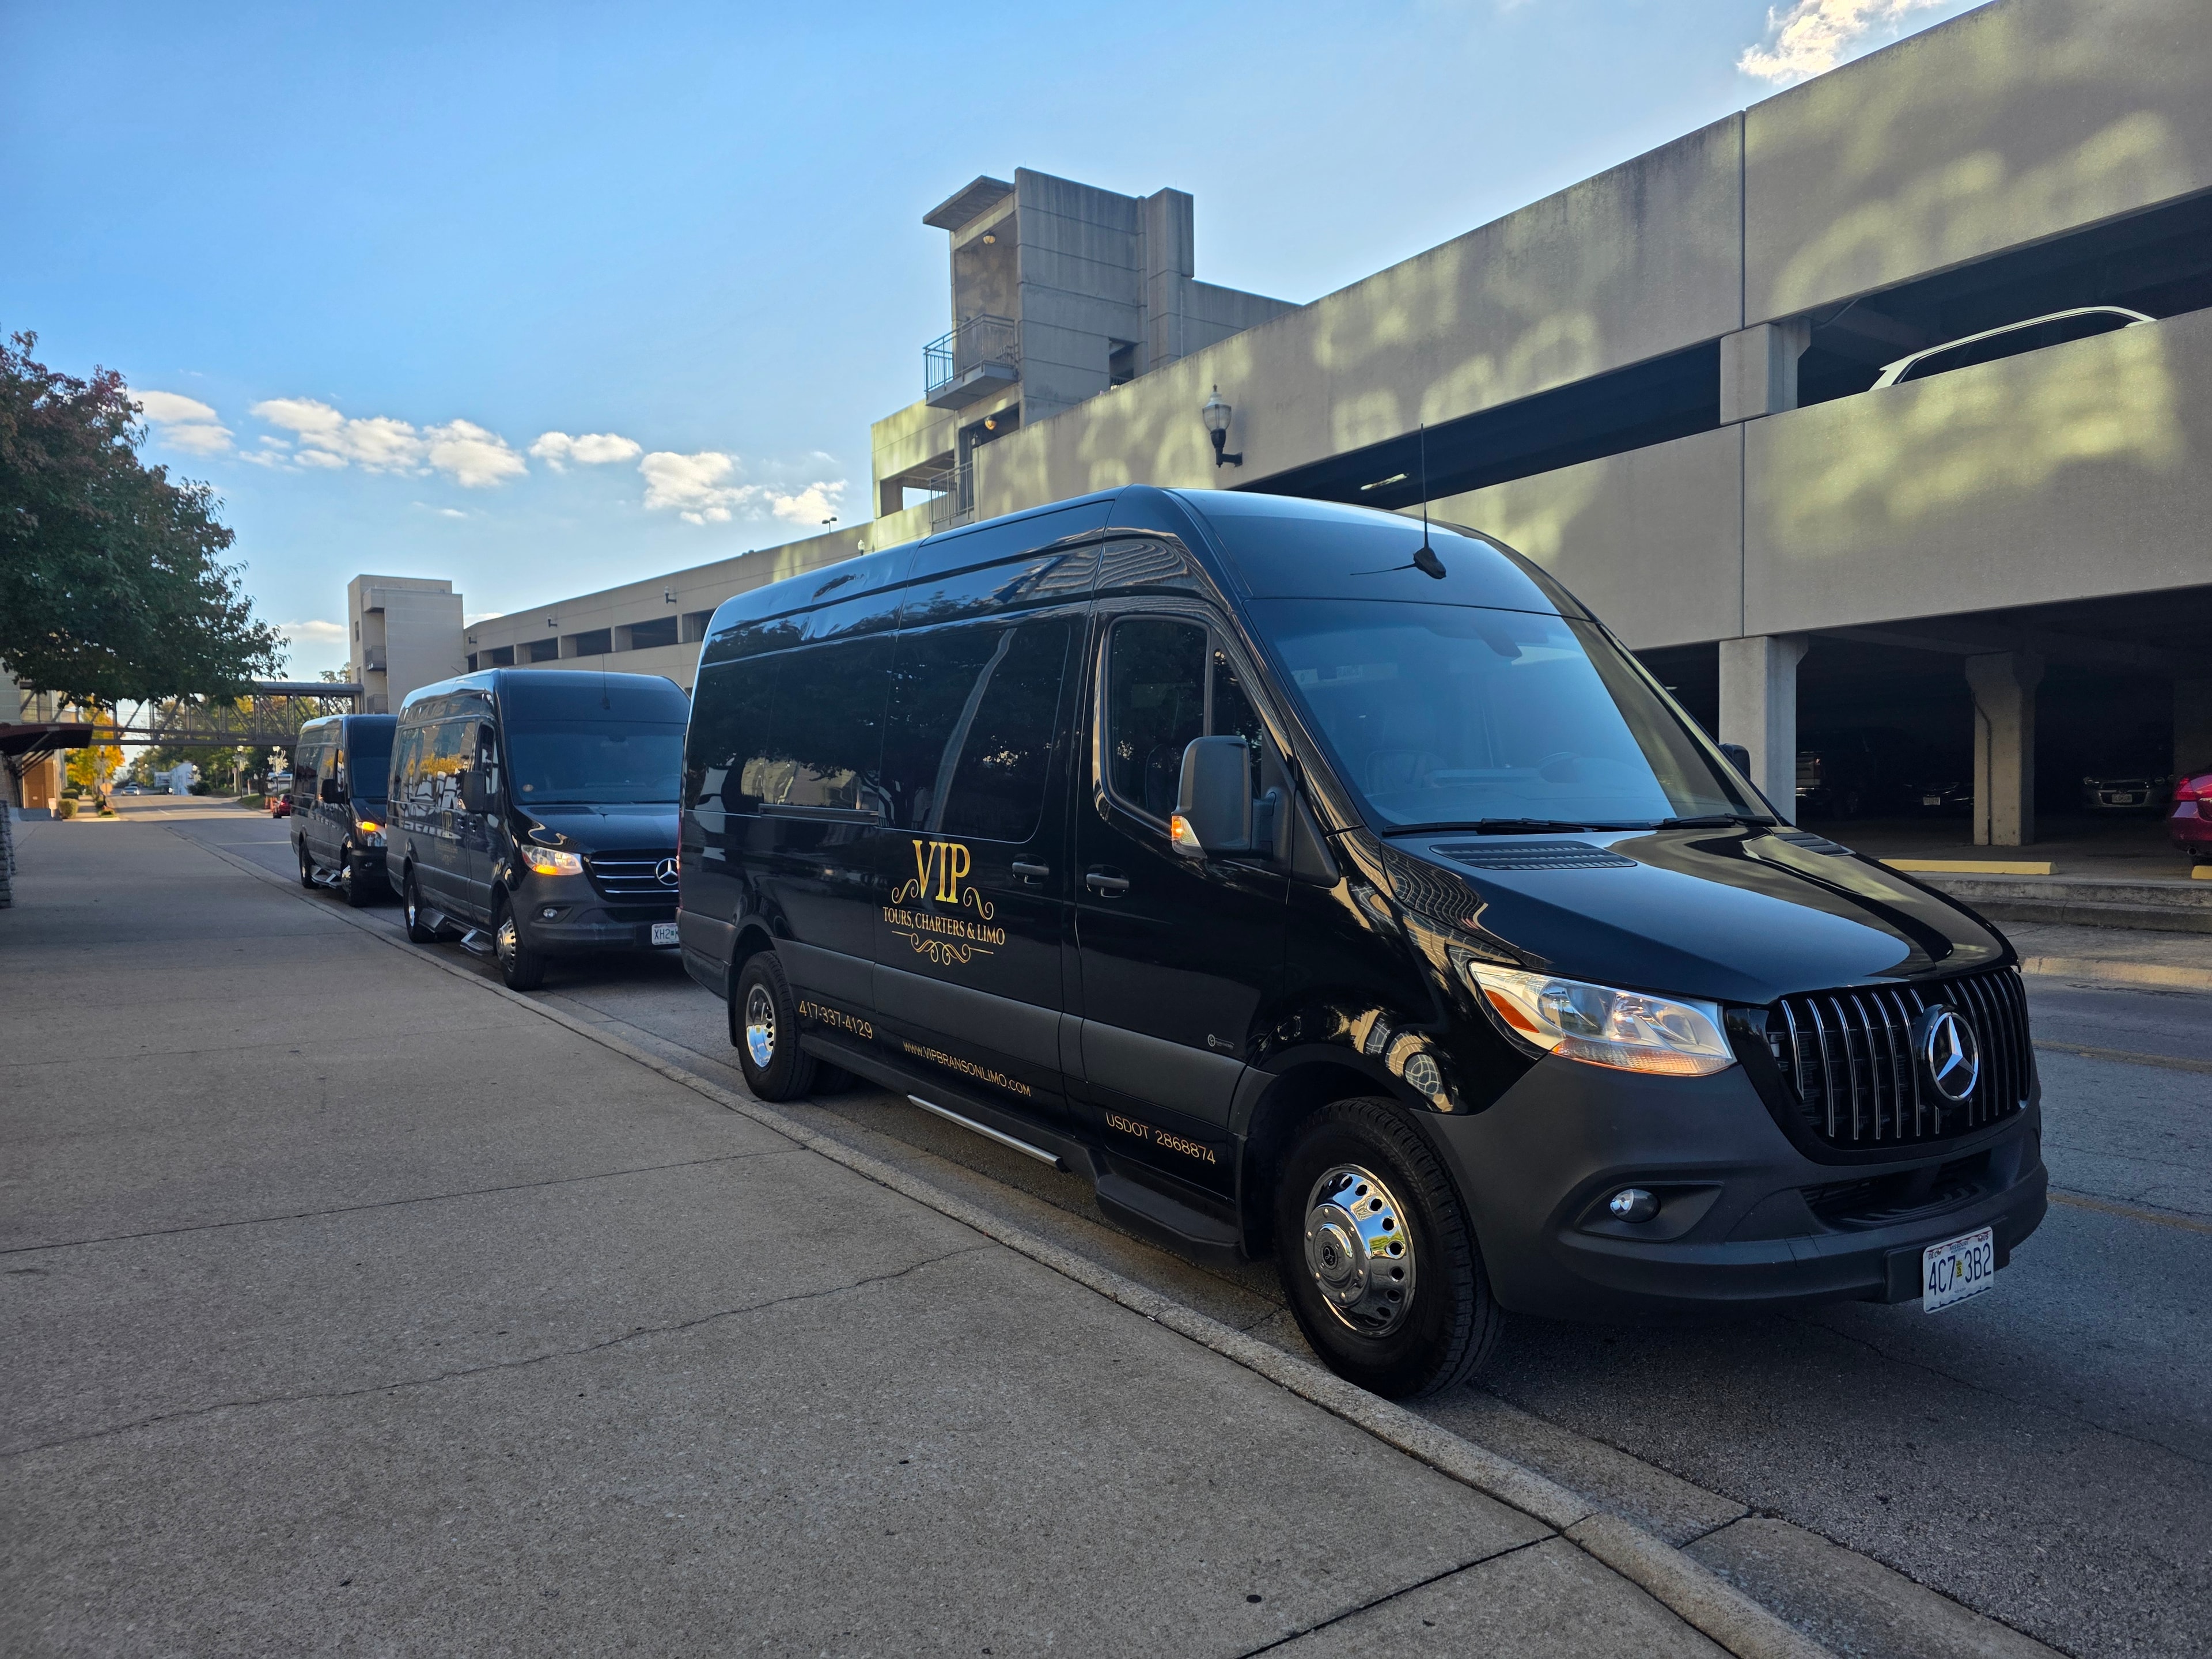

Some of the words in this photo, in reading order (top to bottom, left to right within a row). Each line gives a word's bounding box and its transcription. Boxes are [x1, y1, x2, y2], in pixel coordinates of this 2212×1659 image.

[912, 839, 971, 904] VIP
[882, 906, 914, 929] TOURS,
[915, 912, 964, 937] CHARTERS
[967, 922, 975, 940] &
[977, 924, 1005, 945] LIMO
[799, 1000, 873, 1039] 417-337-4129
[1105, 1112, 1149, 1139] USDOT
[1155, 1130, 1216, 1165] 2868874
[1929, 1255, 1956, 1296] 4C7
[1965, 1243, 1991, 1283] 3B2
